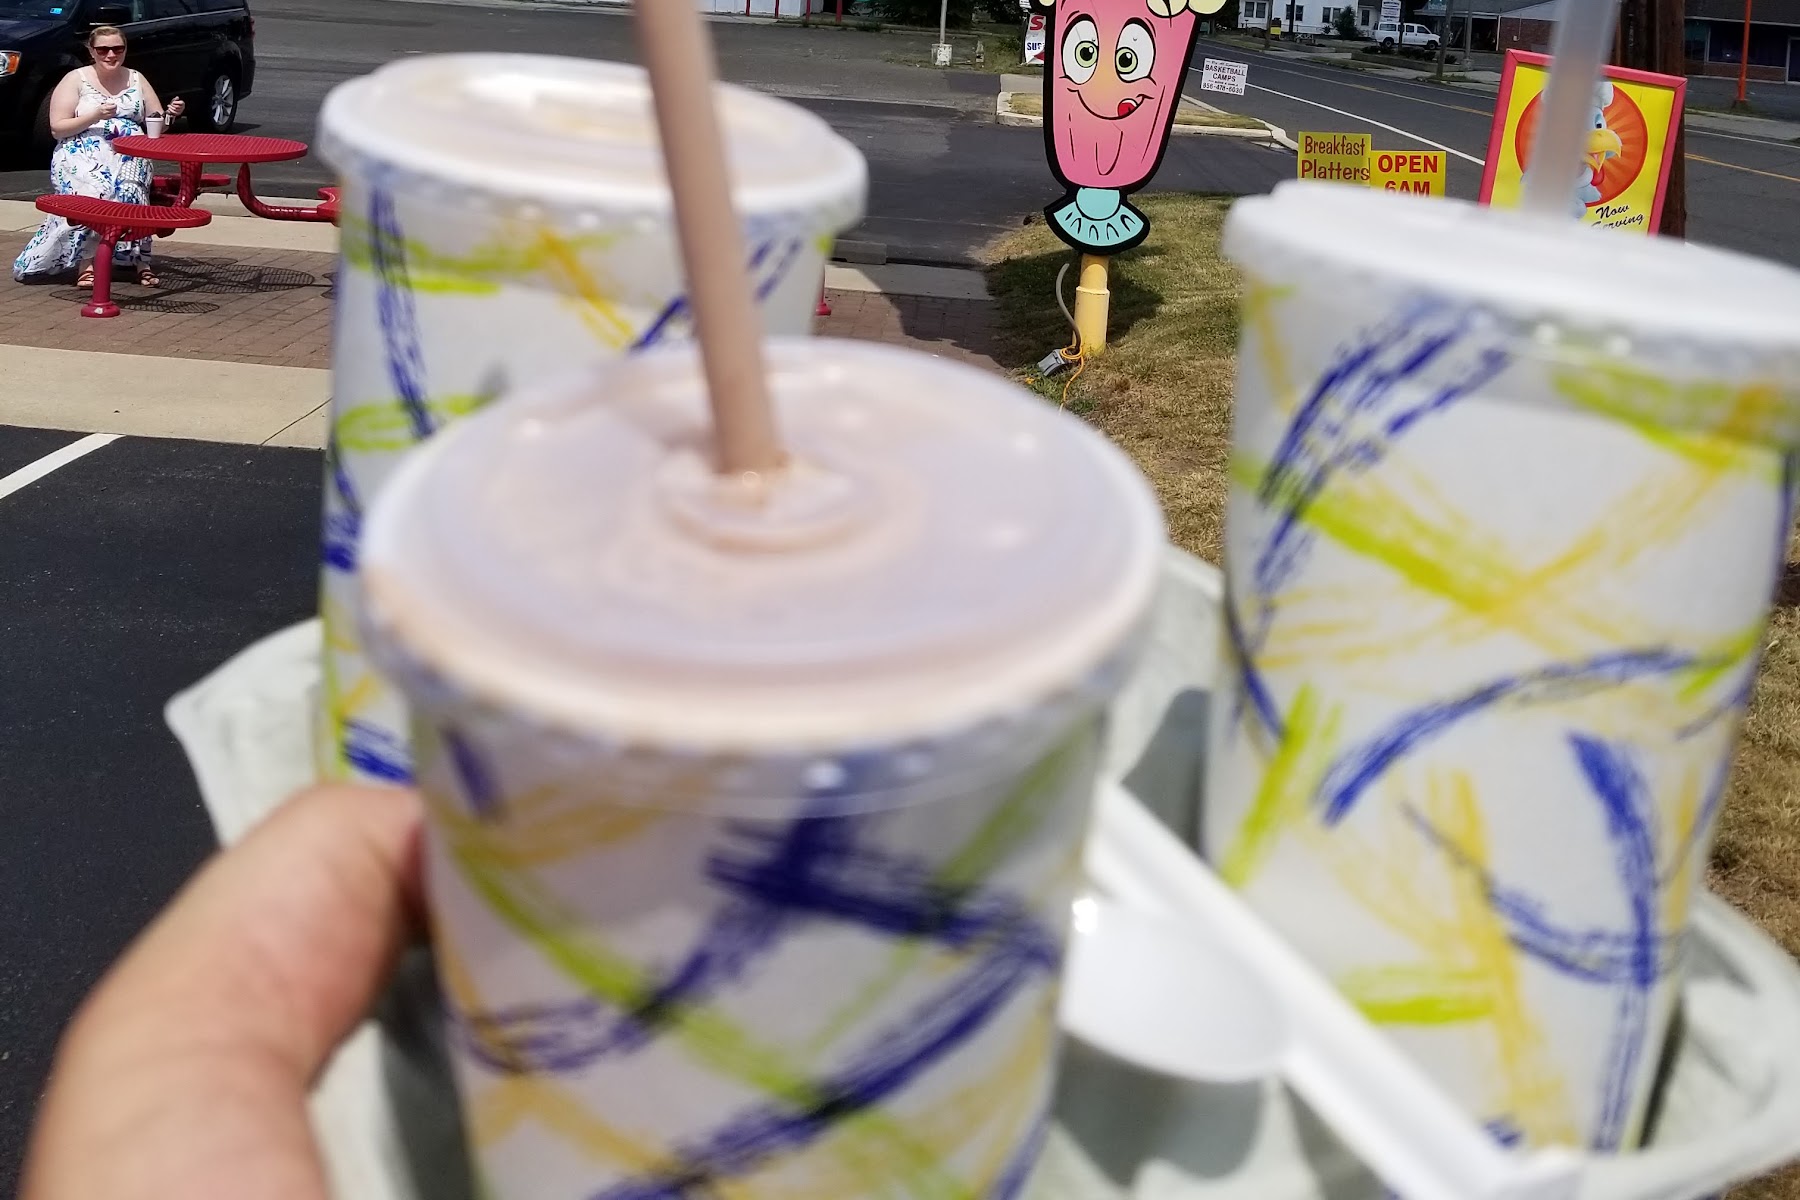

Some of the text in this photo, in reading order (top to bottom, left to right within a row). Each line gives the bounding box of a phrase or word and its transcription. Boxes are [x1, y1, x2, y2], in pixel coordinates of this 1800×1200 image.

[1205, 64, 1245, 76] BASKETBALL
[1213, 73, 1236, 82] CAMPS
[1304, 135, 1365, 156] Breakfast
[1302, 159, 1370, 180] Platters
[1378, 155, 1438, 173] OPEN
[1385, 181, 1430, 198] 6AM
[1596, 205, 1629, 219] Now
